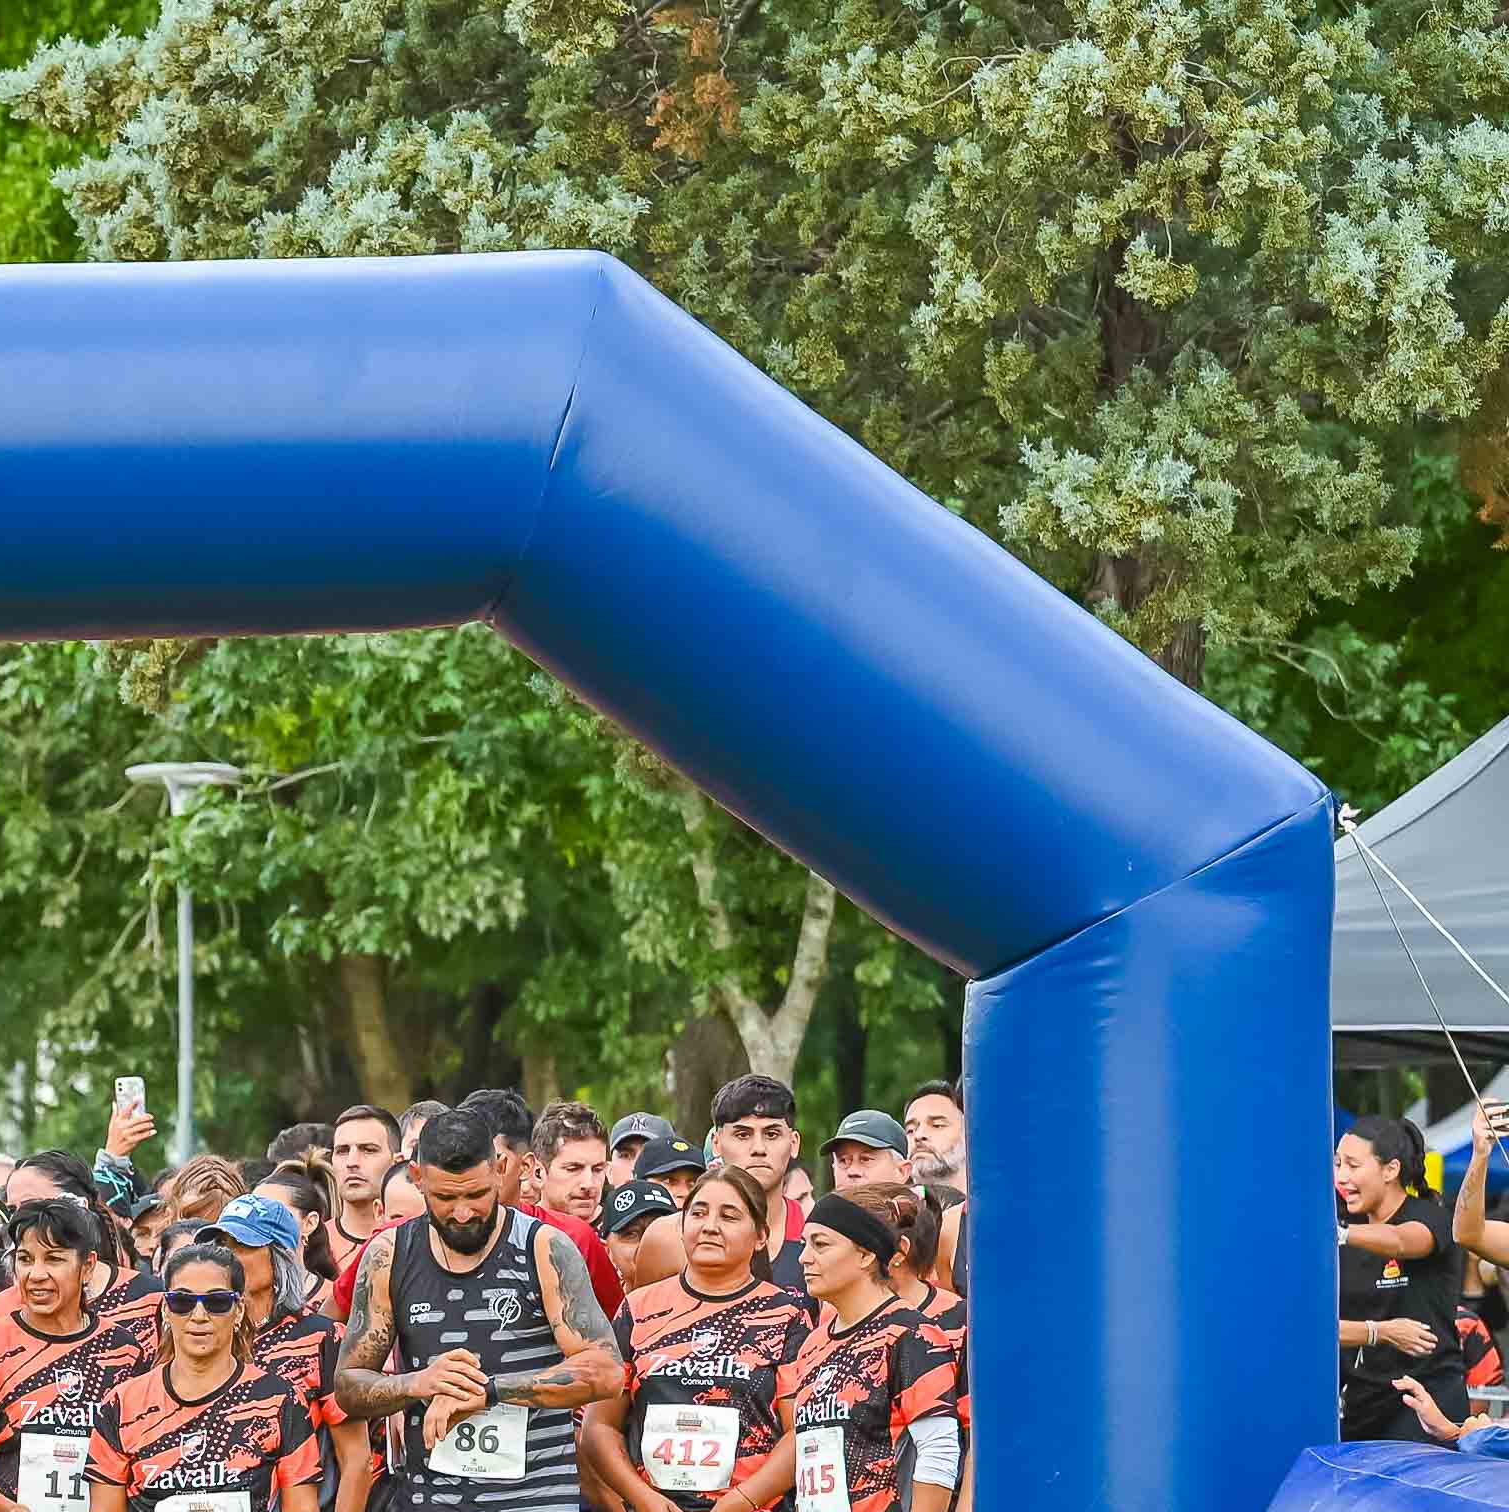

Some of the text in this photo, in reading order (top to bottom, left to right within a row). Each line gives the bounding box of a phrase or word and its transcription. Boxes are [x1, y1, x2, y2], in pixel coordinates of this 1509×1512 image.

[647, 1354, 750, 1381] Zavalla
[680, 1378, 714, 1386] Comuna
[21, 1400, 103, 1427] Zaval
[54, 1426, 87, 1436] Comuna
[454, 1423, 500, 1454] 86
[652, 1439, 721, 1467] 412
[141, 1460, 241, 1490] Zavalla
